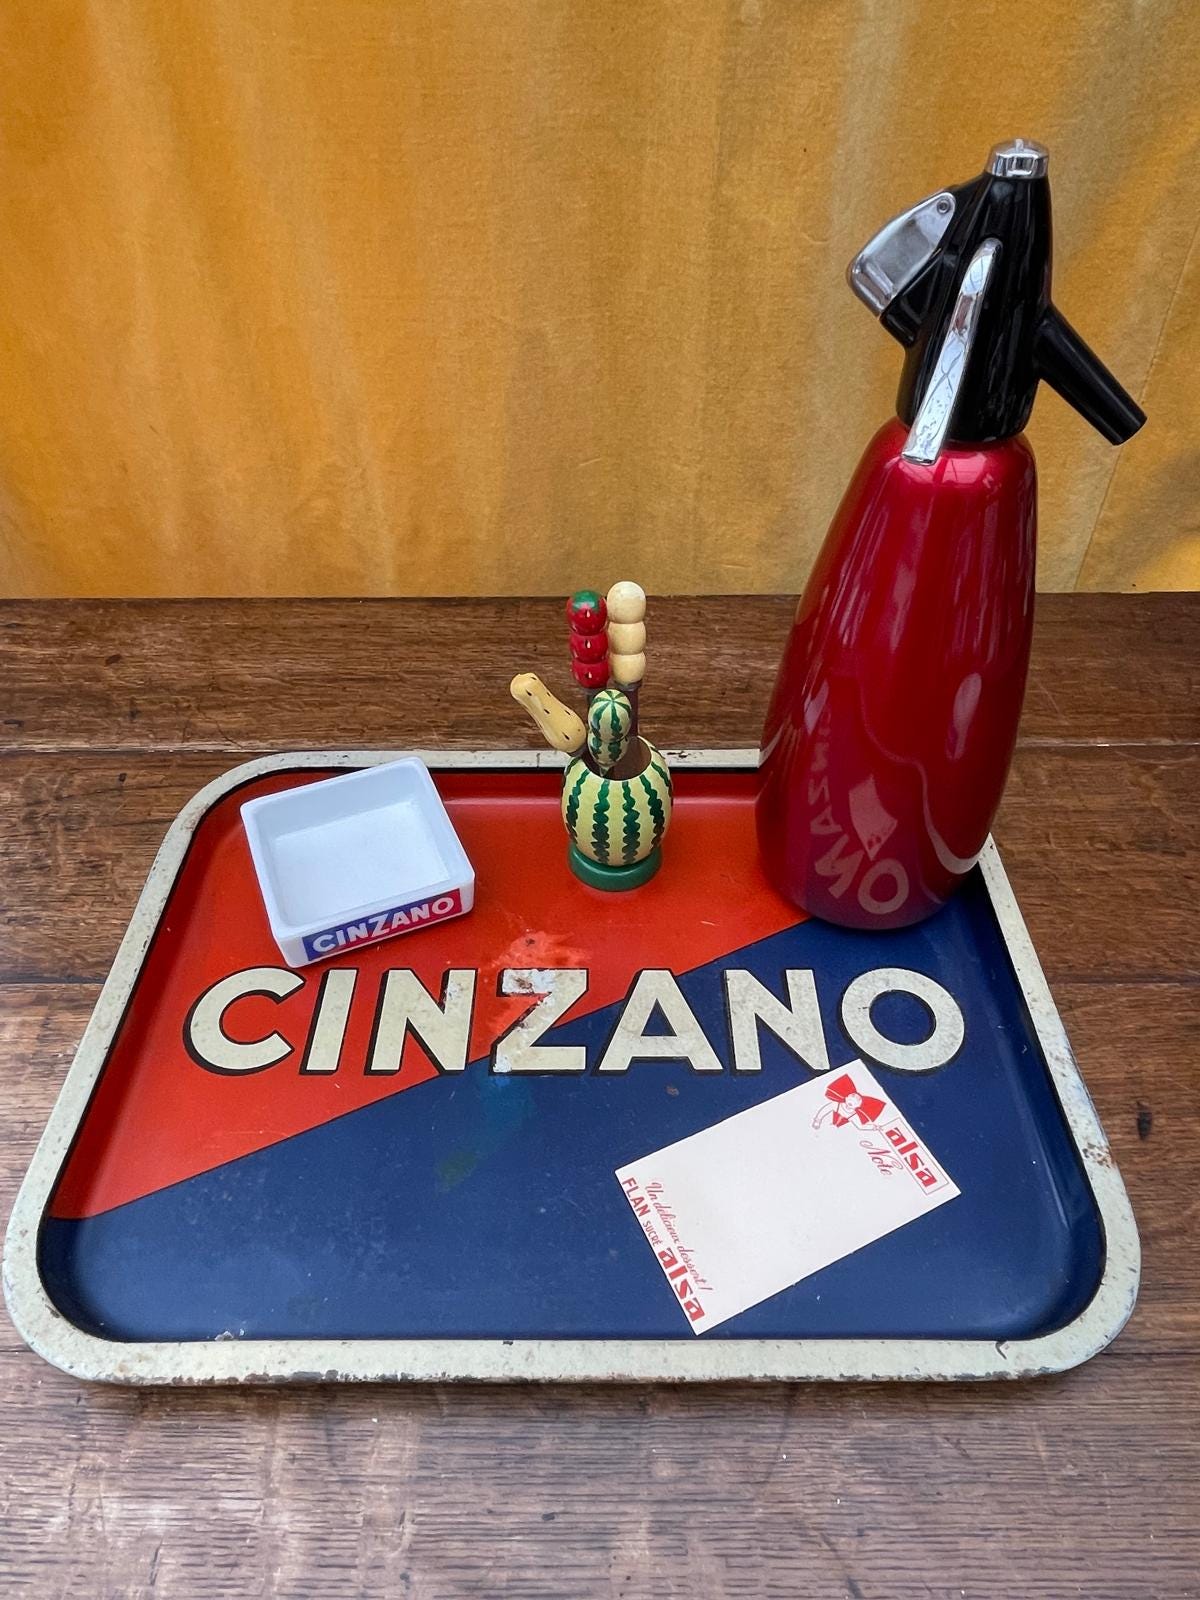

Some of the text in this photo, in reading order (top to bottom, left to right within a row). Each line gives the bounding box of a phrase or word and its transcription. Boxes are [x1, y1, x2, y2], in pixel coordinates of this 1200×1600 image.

[312, 897, 454, 953] CINZANO
[185, 967, 966, 1075] CINZANO
[859, 1140, 904, 1176] Note
[885, 1127, 938, 1188] alsa
[645, 1181, 664, 1203] Un
[622, 1177, 705, 1322] FLAN SUCRÉ alsa
